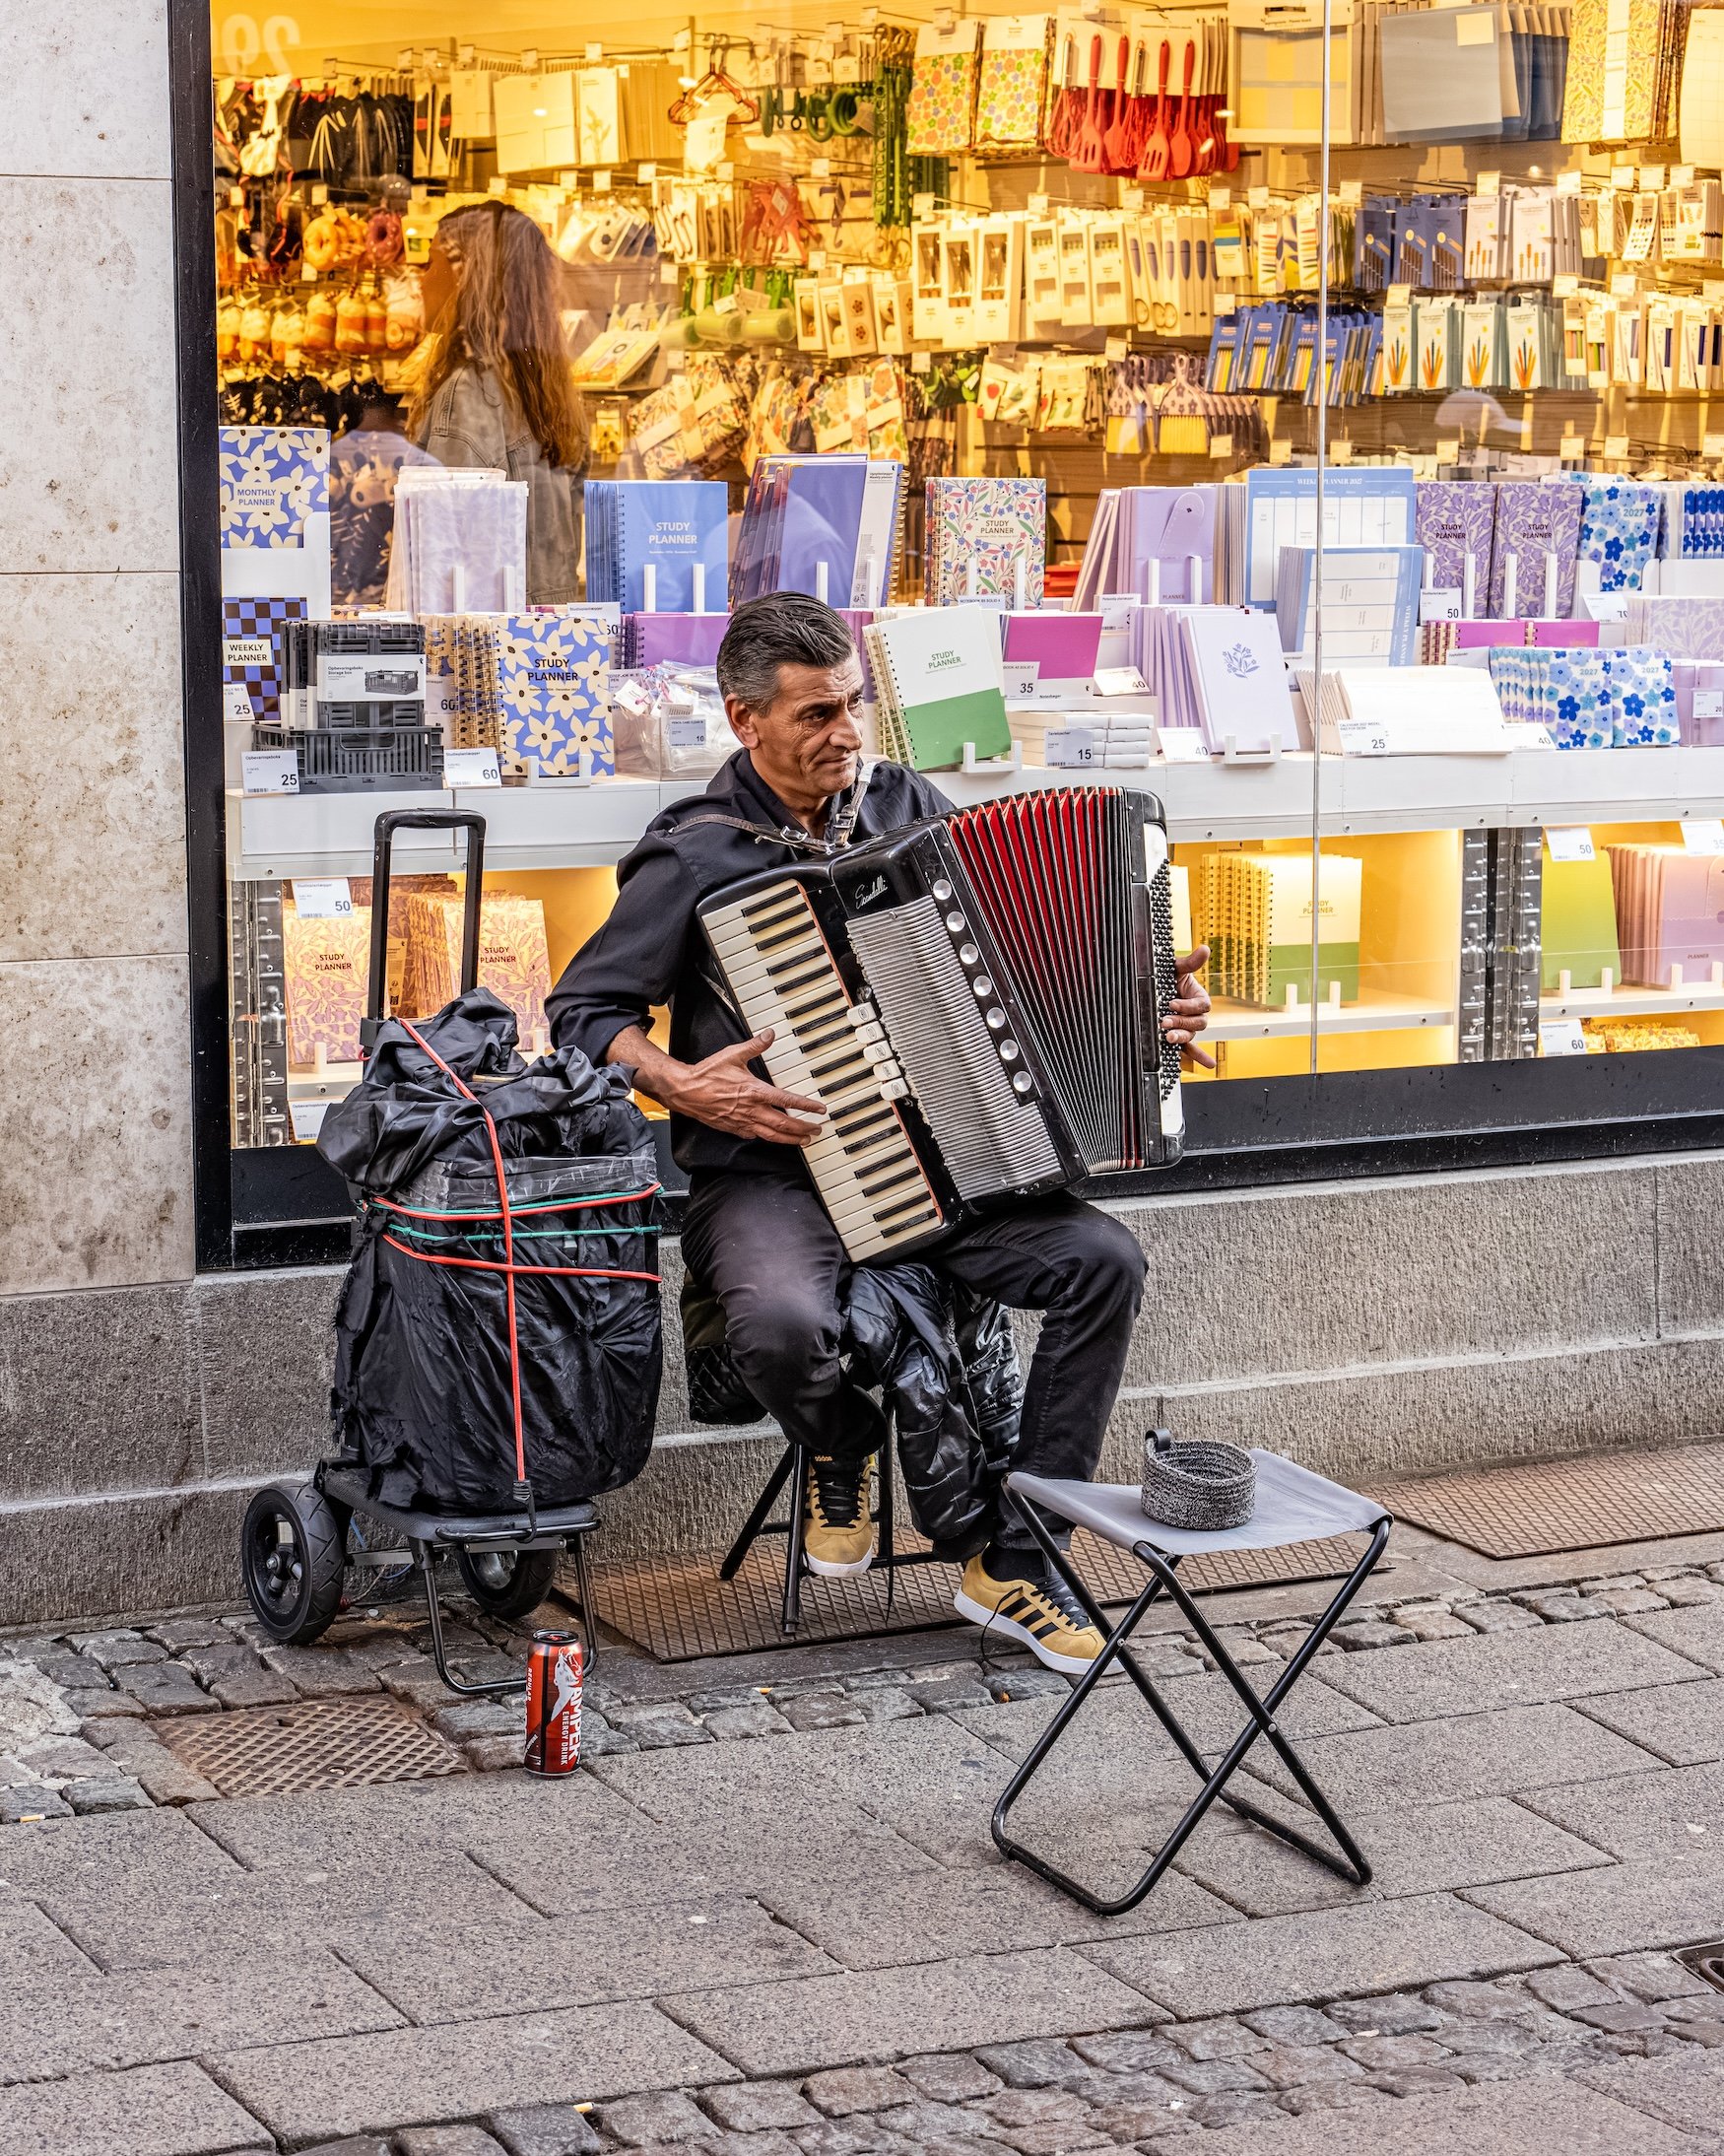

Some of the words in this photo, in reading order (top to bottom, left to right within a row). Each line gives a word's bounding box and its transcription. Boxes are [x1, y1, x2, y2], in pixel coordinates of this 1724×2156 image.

[1623, 508, 1645, 517] 2027
[655, 521, 691, 532] STUDY
[648, 534, 698, 544] PLANNER
[1447, 608, 1459, 619] 50
[931, 650, 955, 661] STUDY
[534, 658, 570, 668] STUDY
[928, 656, 961, 669] PLANNER
[527, 672, 578, 681] PLANNER
[1020, 682, 1033, 694] 35
[1132, 680, 1146, 689] 40
[233, 705, 250, 715] 25
[440, 699, 456, 710] 60
[1371, 739, 1386, 749] 25
[1078, 749, 1092, 760] 15
[281, 774, 298, 786] 25
[482, 769, 498, 780] 60
[1579, 844, 1592, 854] 50
[335, 900, 351, 911] 50
[1571, 1039, 1584, 1050] 60
[562, 1711, 570, 1739] ENERGY
[561, 1741, 569, 1766] DRINK
